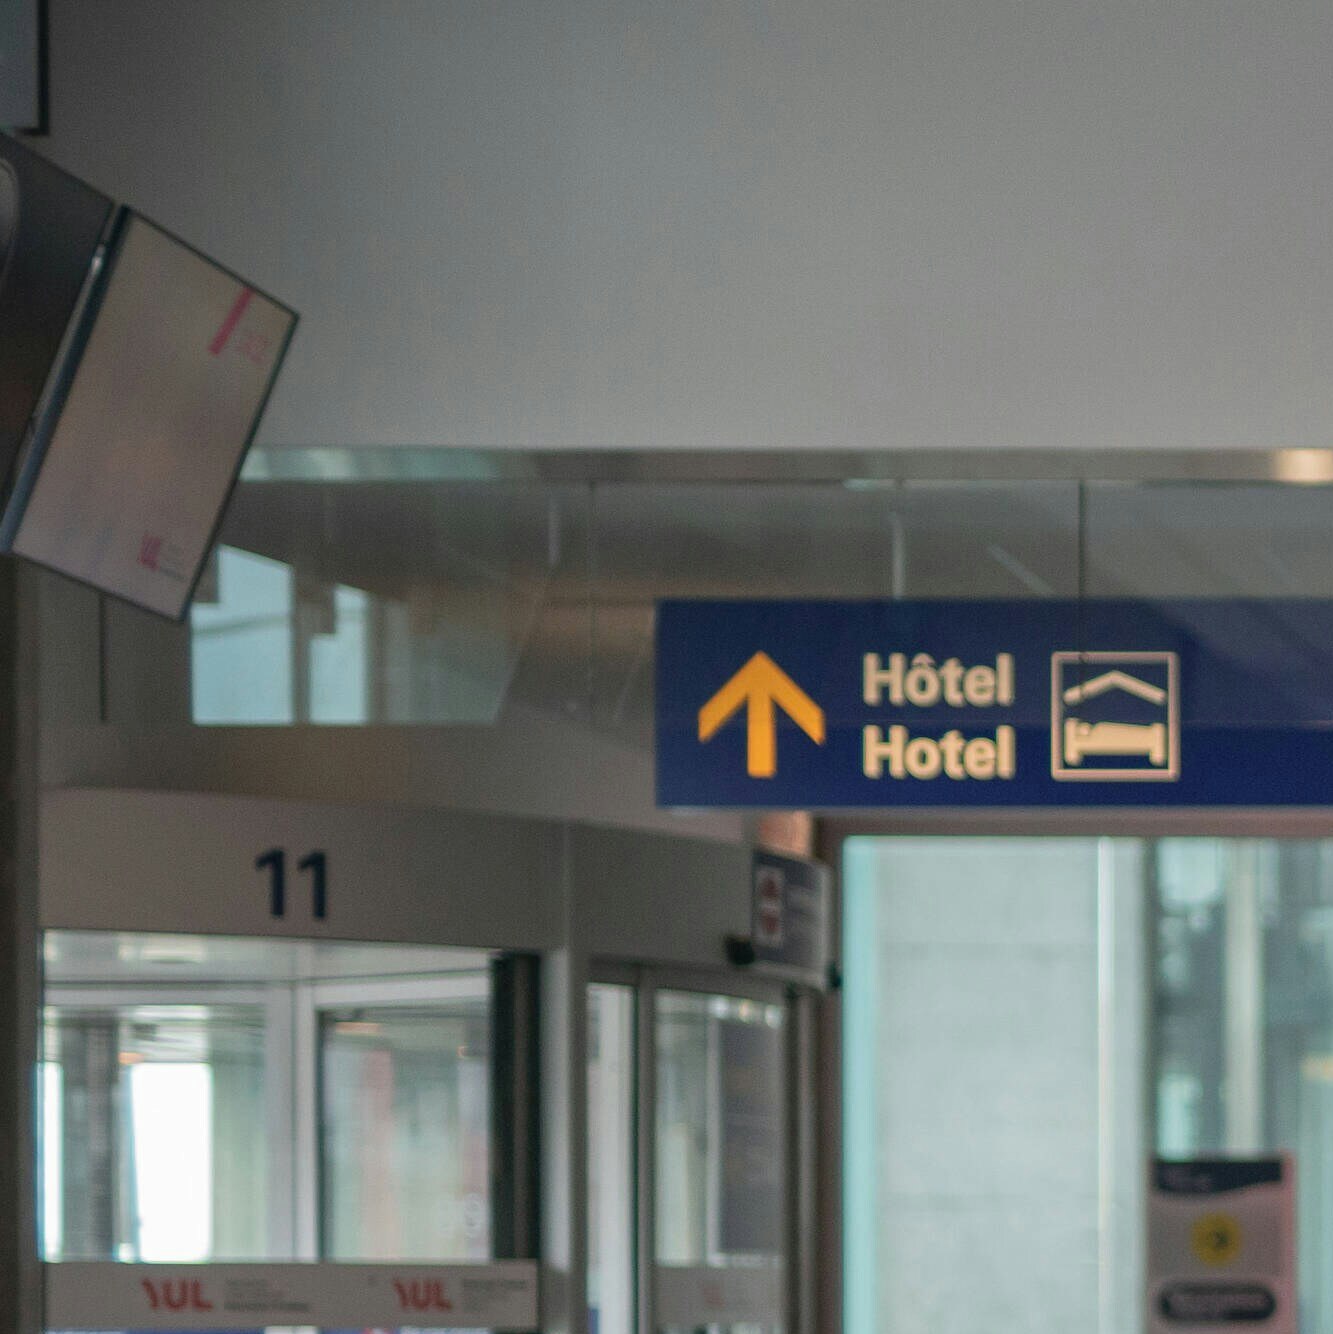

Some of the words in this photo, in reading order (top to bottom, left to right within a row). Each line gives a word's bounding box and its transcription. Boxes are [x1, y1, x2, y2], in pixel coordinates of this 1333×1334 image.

[863, 652, 1015, 707] Hôtel
[863, 724, 1016, 780] Hotel
[255, 848, 326, 918] 11
